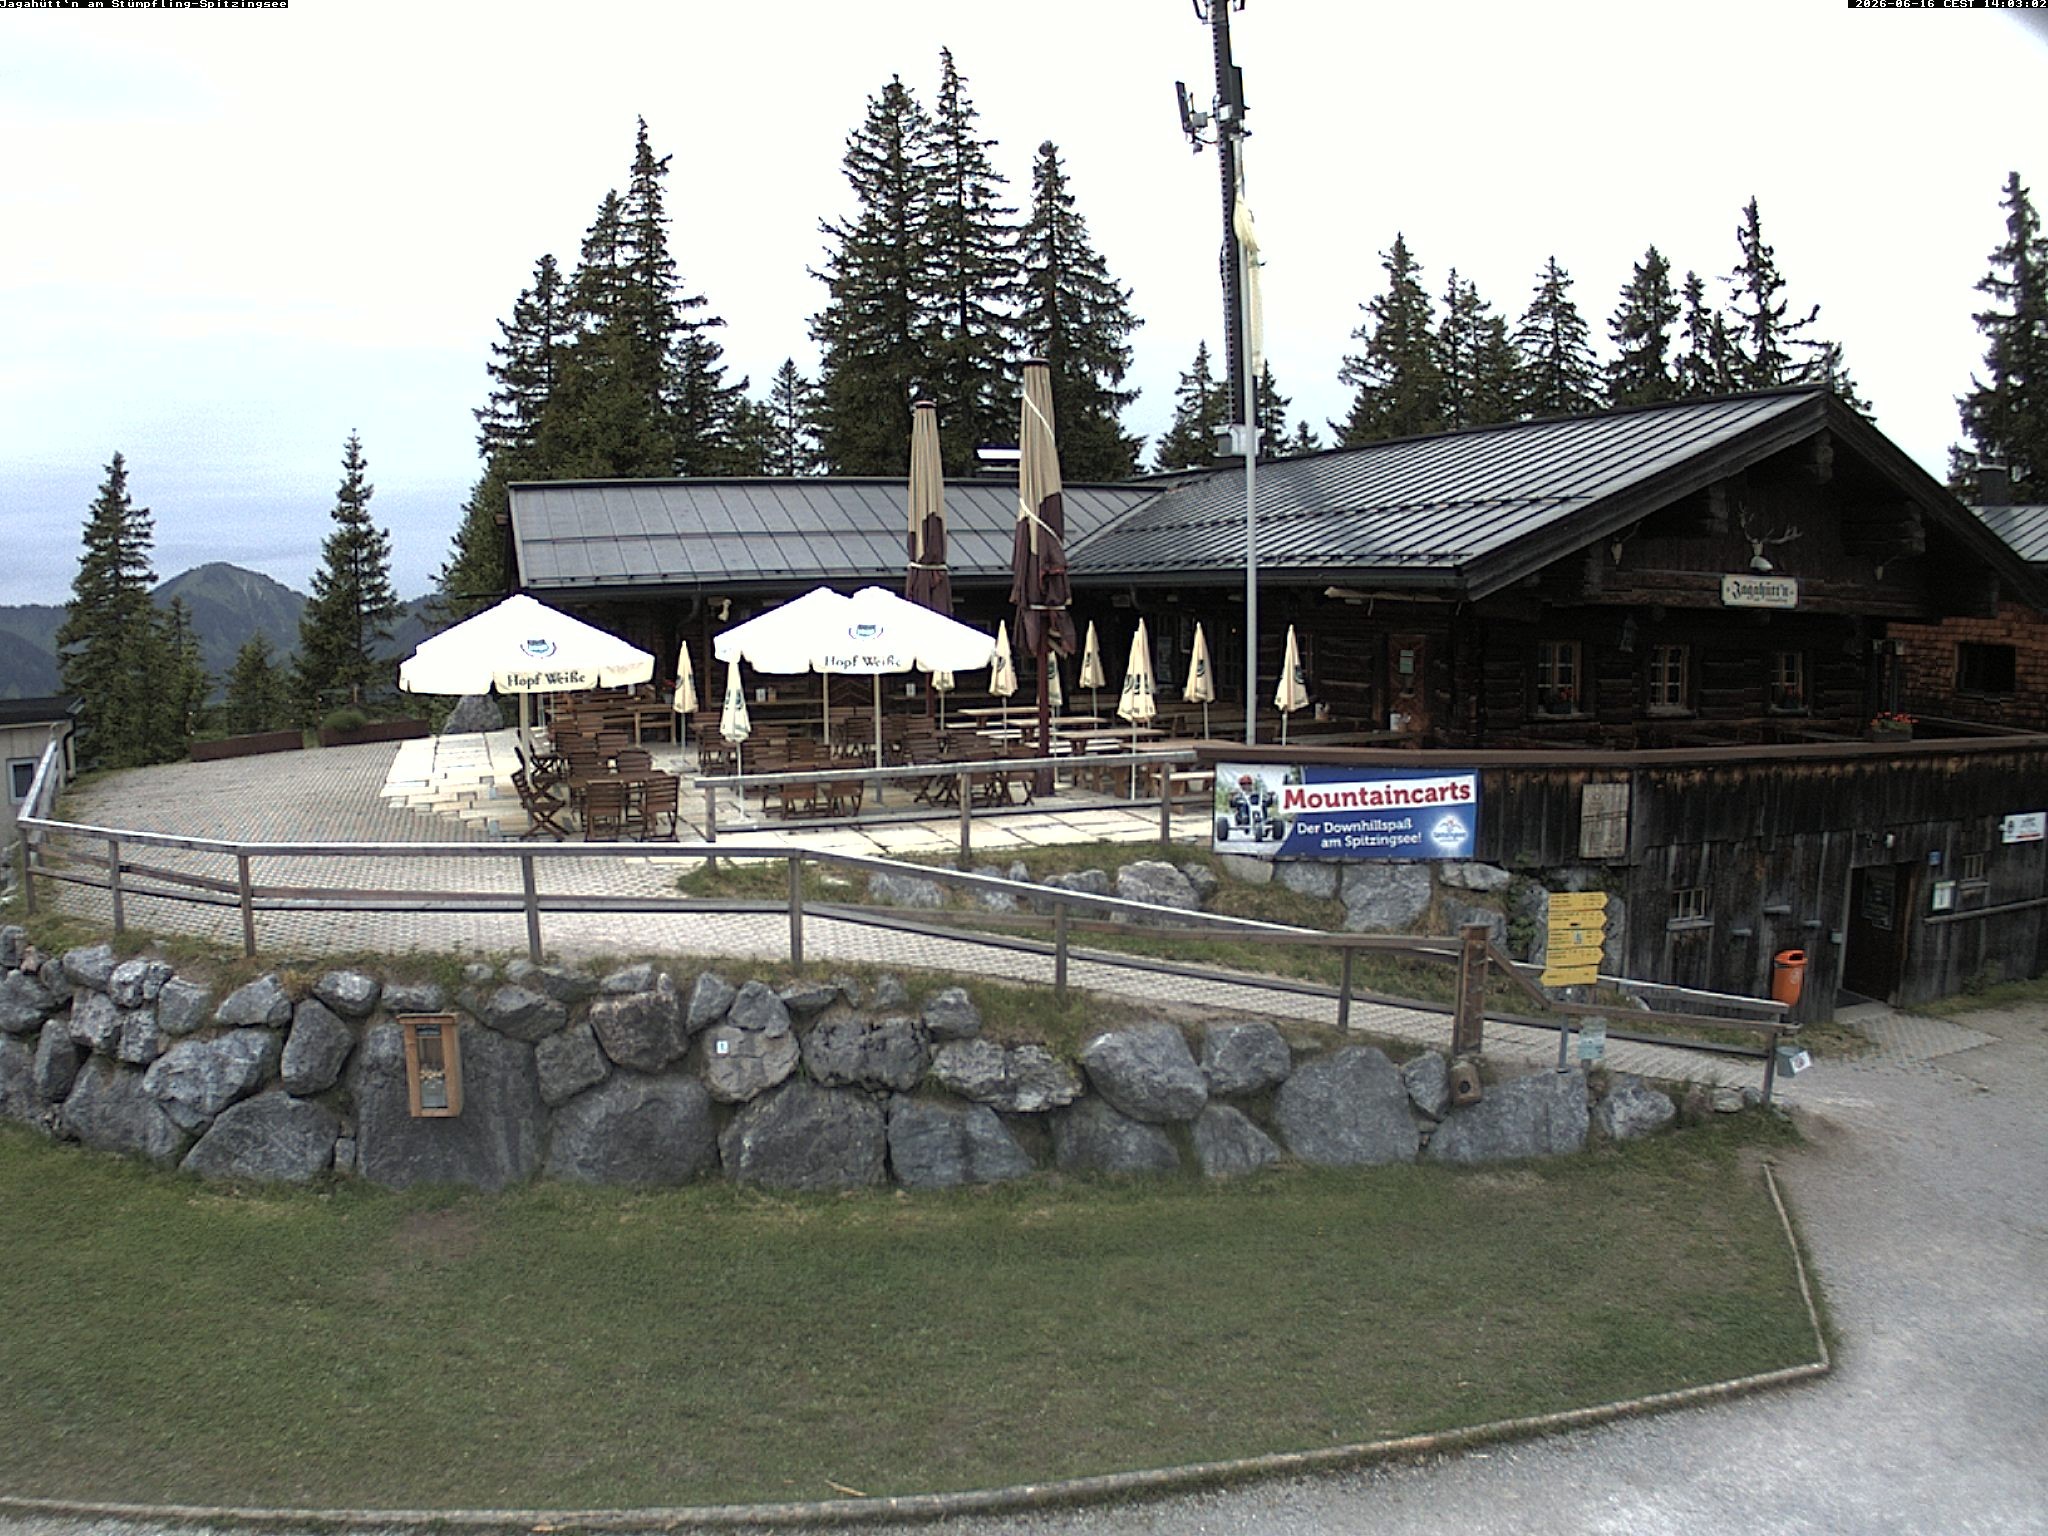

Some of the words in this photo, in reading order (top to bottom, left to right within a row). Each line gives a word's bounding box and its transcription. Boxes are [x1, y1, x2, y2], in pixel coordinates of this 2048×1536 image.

[825, 655, 858, 669] Hopf
[862, 655, 901, 667] Weiße
[507, 672, 542, 690] Hopf
[545, 670, 586, 685] Weiße
[1284, 782, 1471, 810] Mountaincarts
[1297, 822, 1320, 835] Der
[1324, 818, 1414, 834] Downhillspaß
[1321, 837, 1342, 848] am
[1344, 832, 1422, 851] Spitzingsee!
